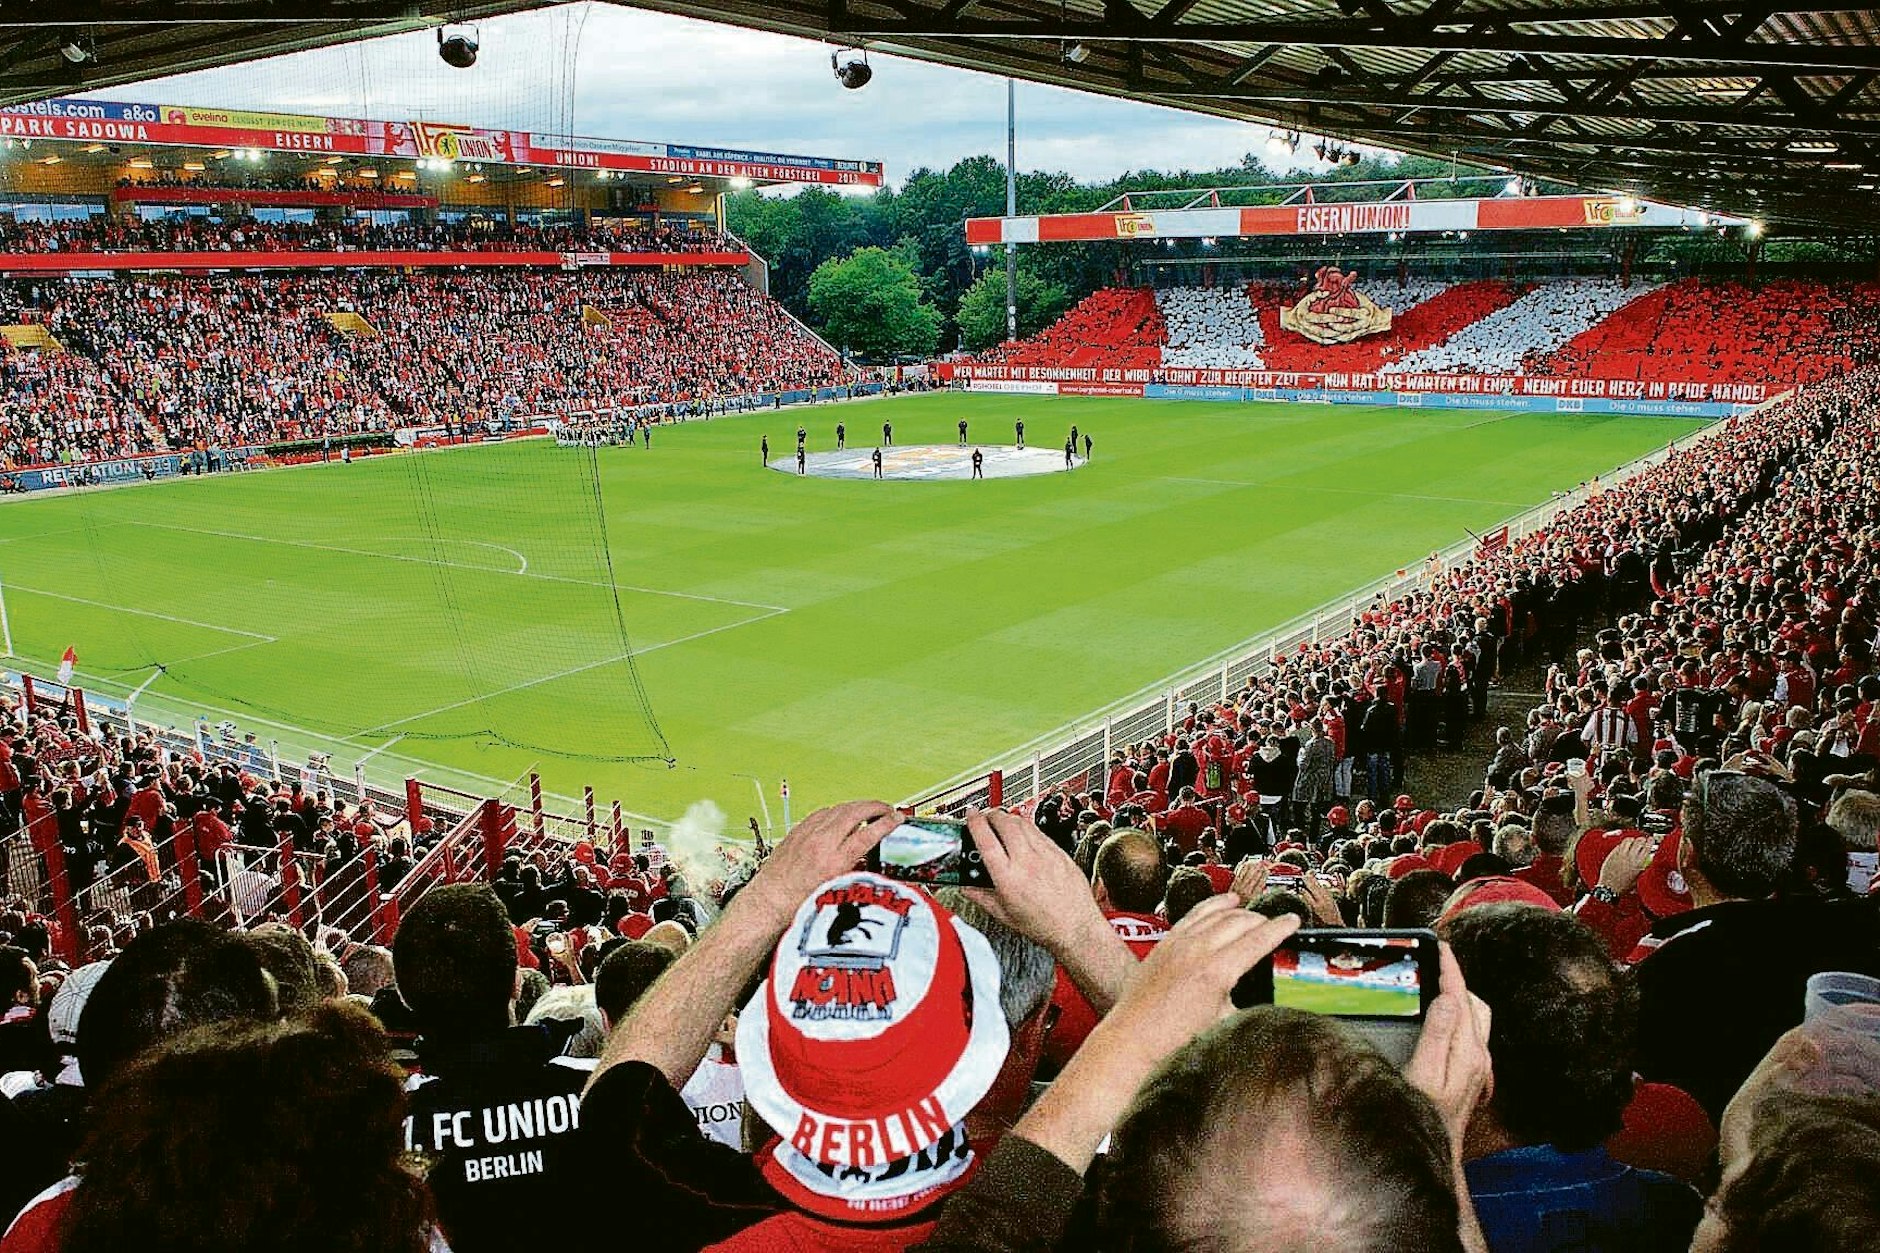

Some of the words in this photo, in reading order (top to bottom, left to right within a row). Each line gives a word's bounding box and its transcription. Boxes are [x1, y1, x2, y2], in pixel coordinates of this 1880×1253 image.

[123, 105, 156, 121] a&o
[192, 112, 228, 123] evelina
[1, 117, 55, 136] PARK
[65, 121, 149, 140] SADOWA
[275, 133, 334, 149] EISERN
[458, 138, 494, 159] UNION
[556, 152, 600, 167] UNION!
[650, 160, 694, 172] STADION
[700, 163, 713, 174] AN
[718, 165, 736, 175] DER
[742, 166, 769, 178] ALTEN
[774, 168, 820, 181] FÖRSTEREI
[839, 173, 859, 184] 2013
[1297, 206, 1350, 232] EISERN
[1354, 205, 1411, 230] UNION!
[953, 366, 972, 379] WER
[974, 366, 1008, 379] WARTET
[1011, 367, 1027, 380] MIT
[1103, 369, 1121, 382] DER
[1124, 369, 1149, 382] WIRD
[1200, 371, 1221, 384] ZUR
[1225, 371, 1273, 386] RECHTEN
[1275, 374, 1300, 387] ZEIT
[1325, 375, 1348, 389] NUN
[1352, 376, 1375, 390] HAT
[1406, 376, 1456, 391] WARTEN
[1460, 376, 1480, 392] EIN
[1524, 379, 1568, 396] NEHMT
[1571, 380, 1605, 396] EUER
[1609, 381, 1646, 397] HERZ
[1649, 382, 1665, 398] IN
[1668, 382, 1709, 399] BEIDE
[1712, 383, 1767, 401] HÄNDE!
[1471, 397, 1495, 406] muss
[1558, 399, 1582, 410] DKB
[1609, 400, 1627, 411] Die
[1637, 403, 1664, 412] muss
[401, 1115, 423, 1152] 1.
[433, 1111, 474, 1151] FC
[792, 1094, 954, 1167] BERLIN
[465, 1150, 544, 1183] BERLIN
